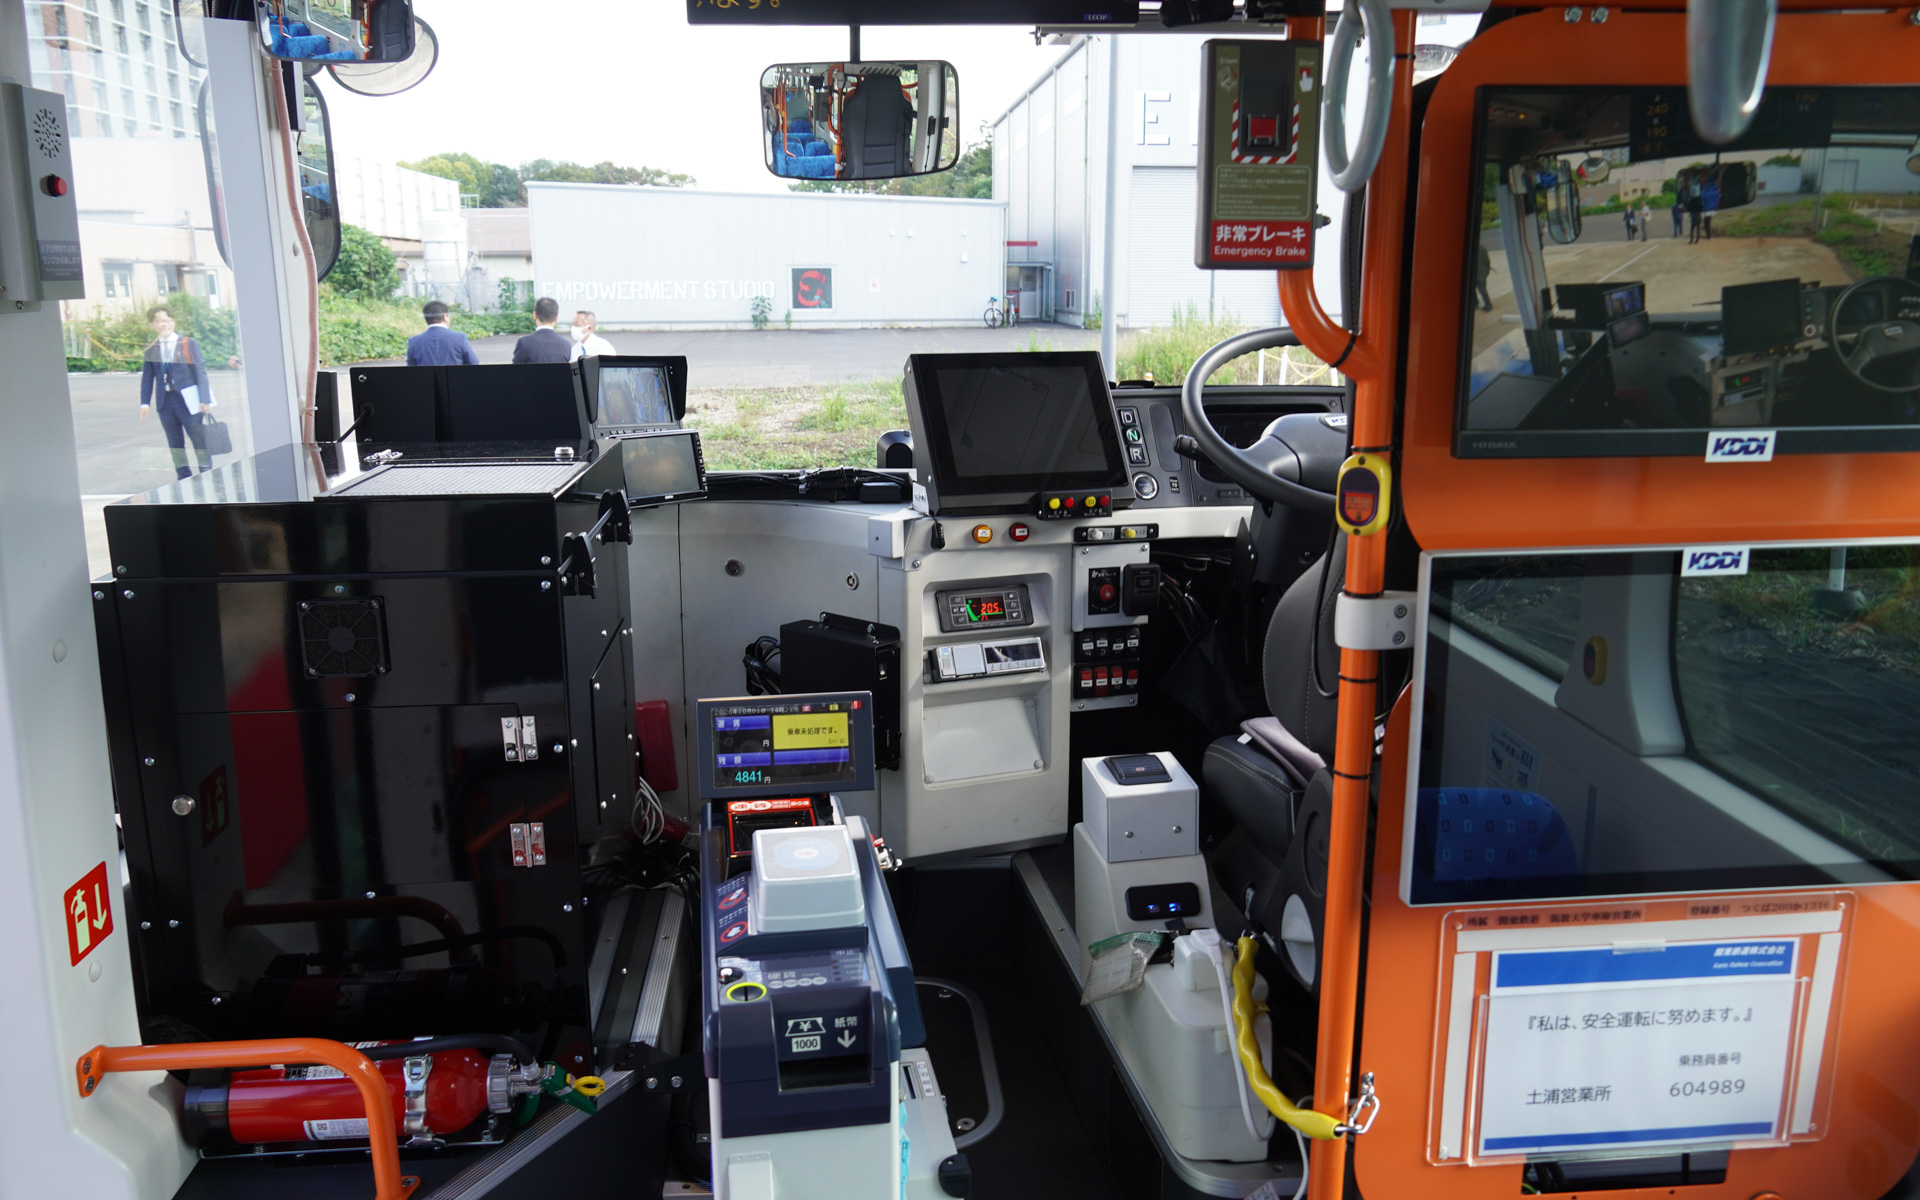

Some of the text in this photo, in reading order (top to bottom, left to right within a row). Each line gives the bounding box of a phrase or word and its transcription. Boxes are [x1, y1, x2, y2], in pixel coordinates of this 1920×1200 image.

[1216, 225, 1306, 242] 非常ブレーキ
[1214, 245, 1306, 258] Emergency Brake
[541, 280, 775, 301] EMPOWERMENT STUDIO
[1124, 412, 1133, 423] D
[1128, 430, 1138, 441] N
[1712, 436, 1769, 456] KDDI
[1133, 449, 1142, 460] R
[1688, 550, 1743, 570] KDDI
[787, 726, 837, 736] 乗車未処理です。
[762, 739, 770, 747] 円
[735, 770, 771, 784] 4841 円
[1498, 914, 1540, 926] 関東鉄道
[834, 1016, 858, 1028] 紙幣
[1527, 1006, 1753, 1032] 『私は、安全運転に努めます。』
[793, 1038, 819, 1049] 1000
[1678, 1052, 1742, 1067] 乗務員番号
[1669, 1078, 1746, 1098] 604989
[1525, 1085, 1612, 1105] 土浦営業所
